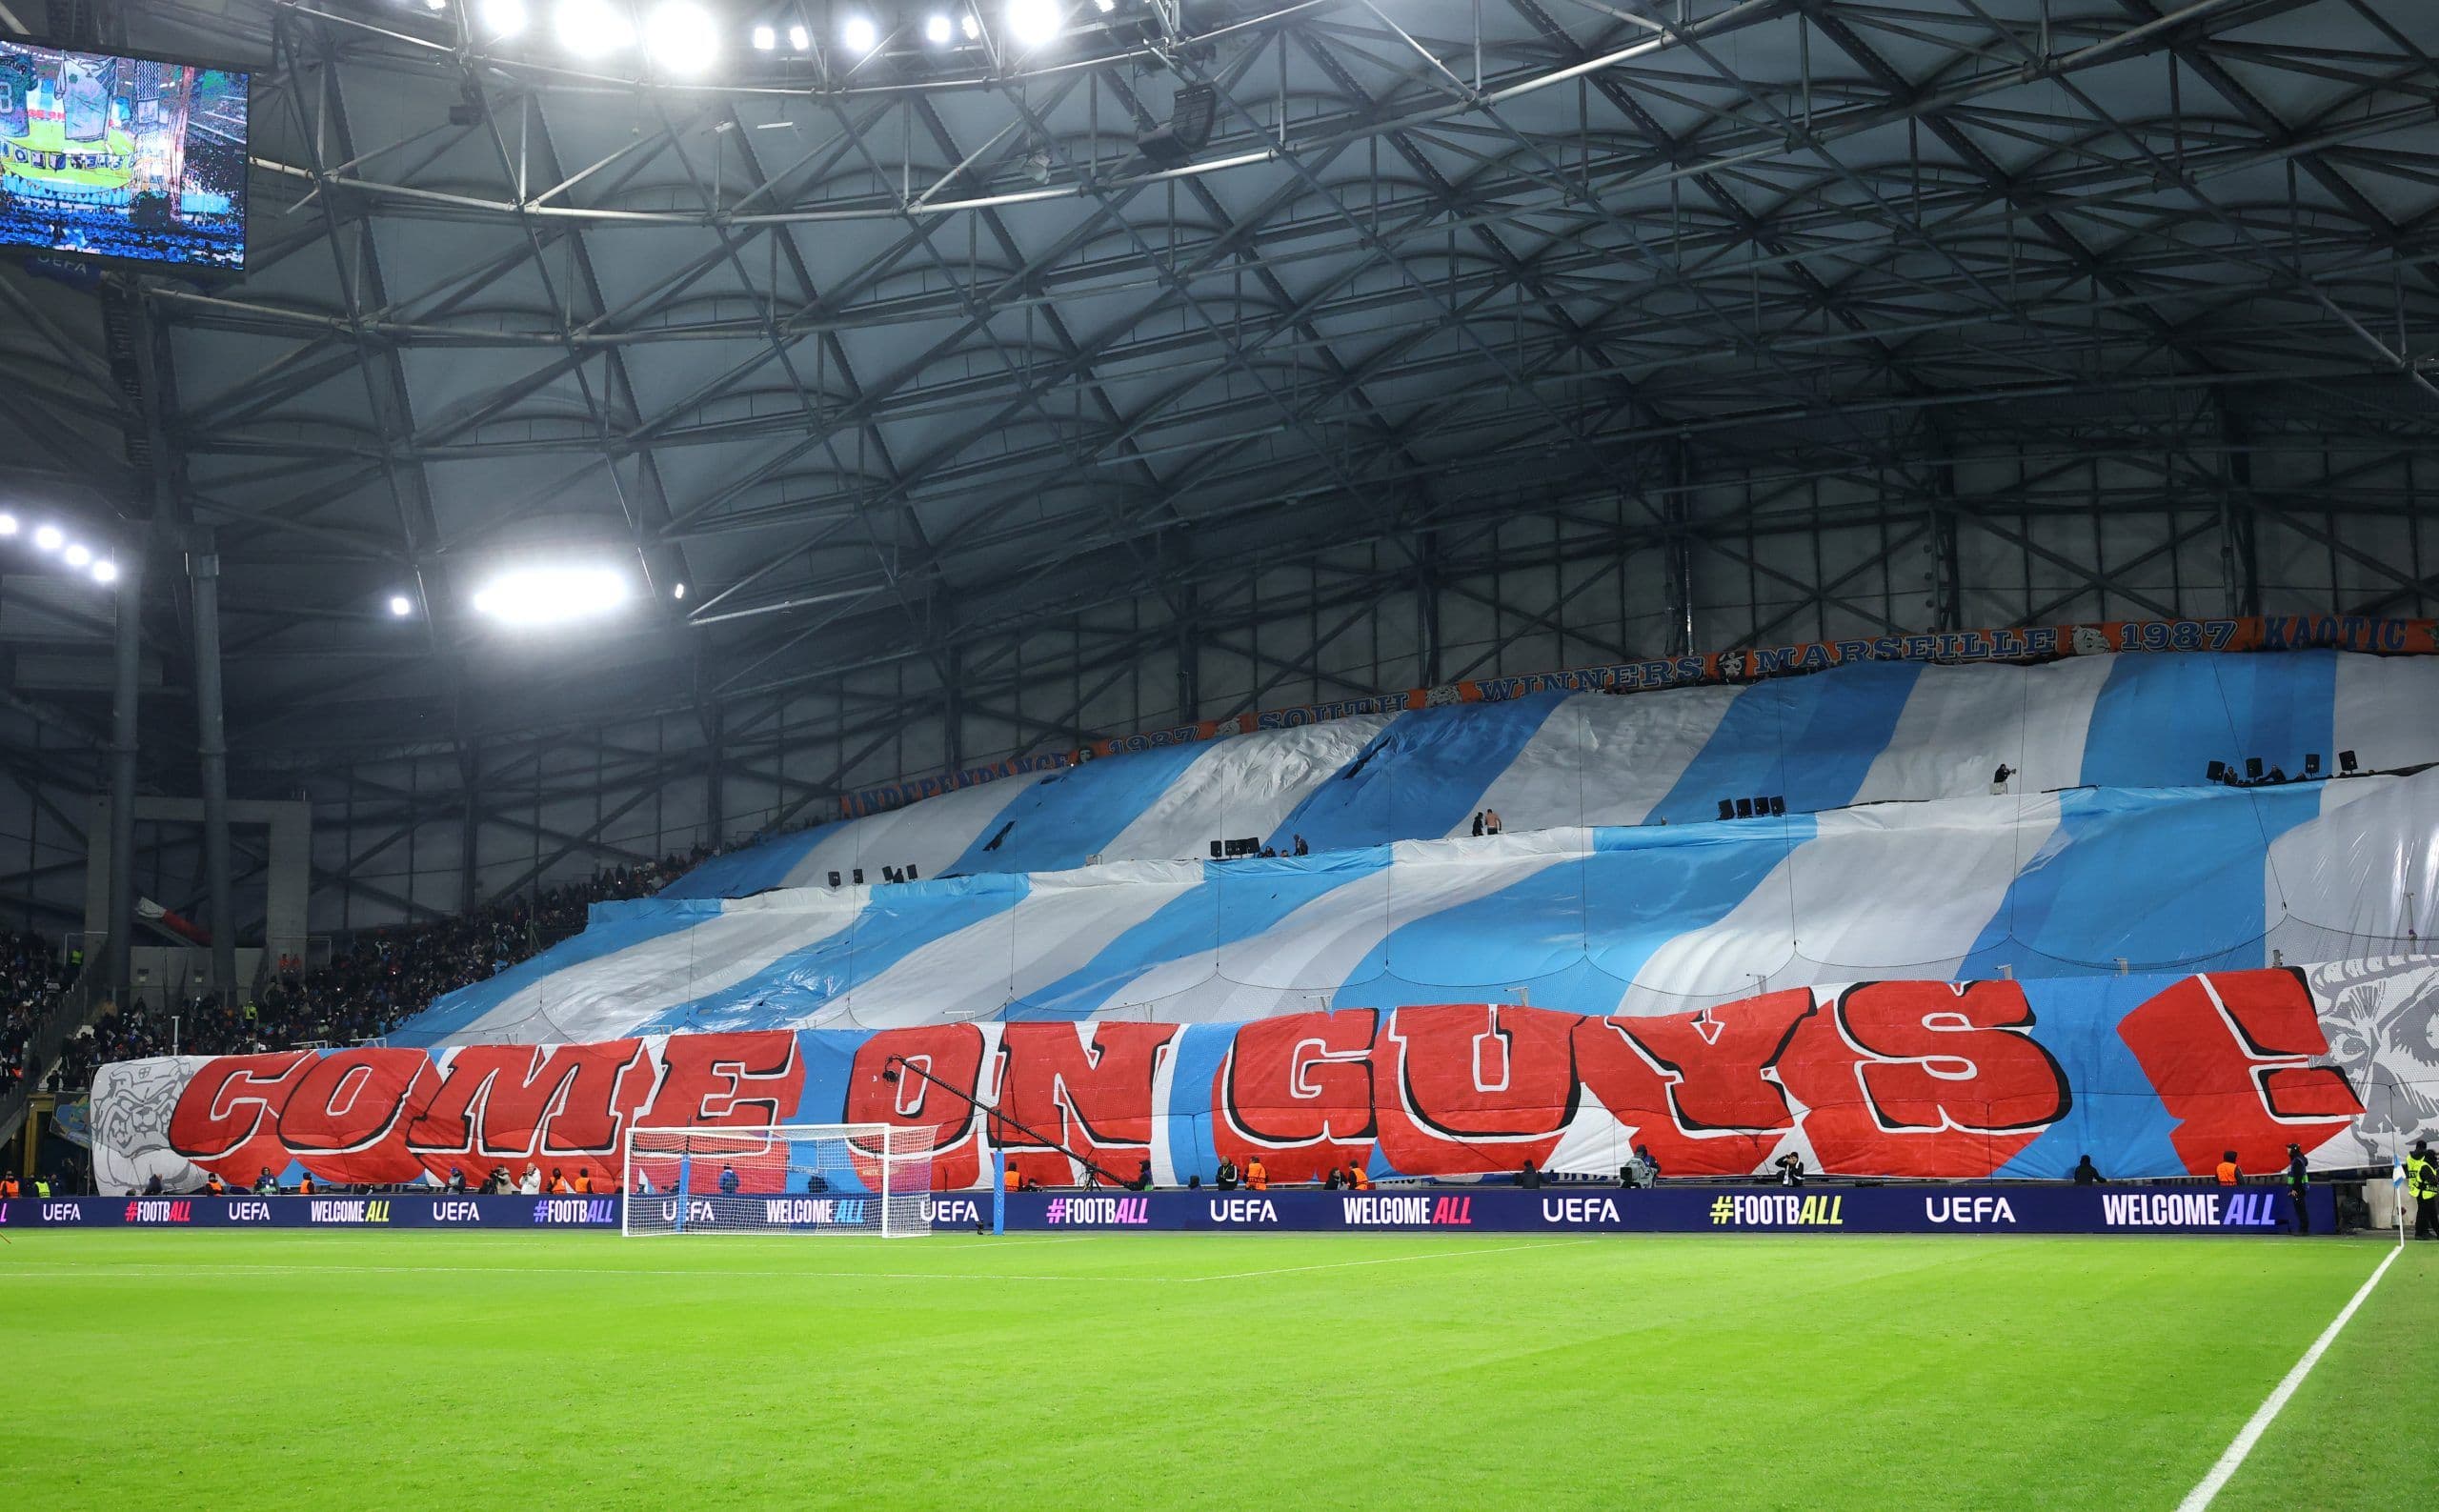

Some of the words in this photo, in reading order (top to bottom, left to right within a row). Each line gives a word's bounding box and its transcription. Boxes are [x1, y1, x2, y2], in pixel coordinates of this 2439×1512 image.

[2264, 615, 2408, 652] KAOTIC
[1108, 725, 1199, 756] 1987
[1257, 693, 1410, 731] SOUTH
[1476, 656, 1705, 701] WINNERS
[1754, 626, 2059, 675] MARSEILLE
[2121, 620, 2239, 652] 1987
[170, 1030, 805, 1181] COME
[844, 1021, 1189, 1186] ON
[1212, 979, 2072, 1179] GUYS
[43, 1203, 81, 1220] UEFA
[125, 1200, 191, 1222] #FOOTBALL
[229, 1202, 271, 1220] UEFA
[311, 1200, 364, 1222] WELCOME
[365, 1200, 390, 1222] ALL
[433, 1201, 480, 1220] UEFA
[533, 1200, 614, 1222] #FOOTBALL
[662, 1201, 716, 1221] UFA
[766, 1200, 833, 1222] WELCOME
[834, 1200, 864, 1222] ALL
[920, 1200, 980, 1222] UEFA
[1047, 1198, 1149, 1223] #FOOTBALL
[1210, 1199, 1278, 1222] UEFA
[1343, 1197, 1430, 1224] WELCOME
[1432, 1197, 1472, 1224] ALL
[1542, 1198, 1621, 1222] UEFA
[1709, 1195, 1844, 1225] #FOOTBALL
[1925, 1196, 2016, 1223] UEFA
[2103, 1194, 2221, 1225] WELCOME
[2223, 1194, 2276, 1225] ALL
